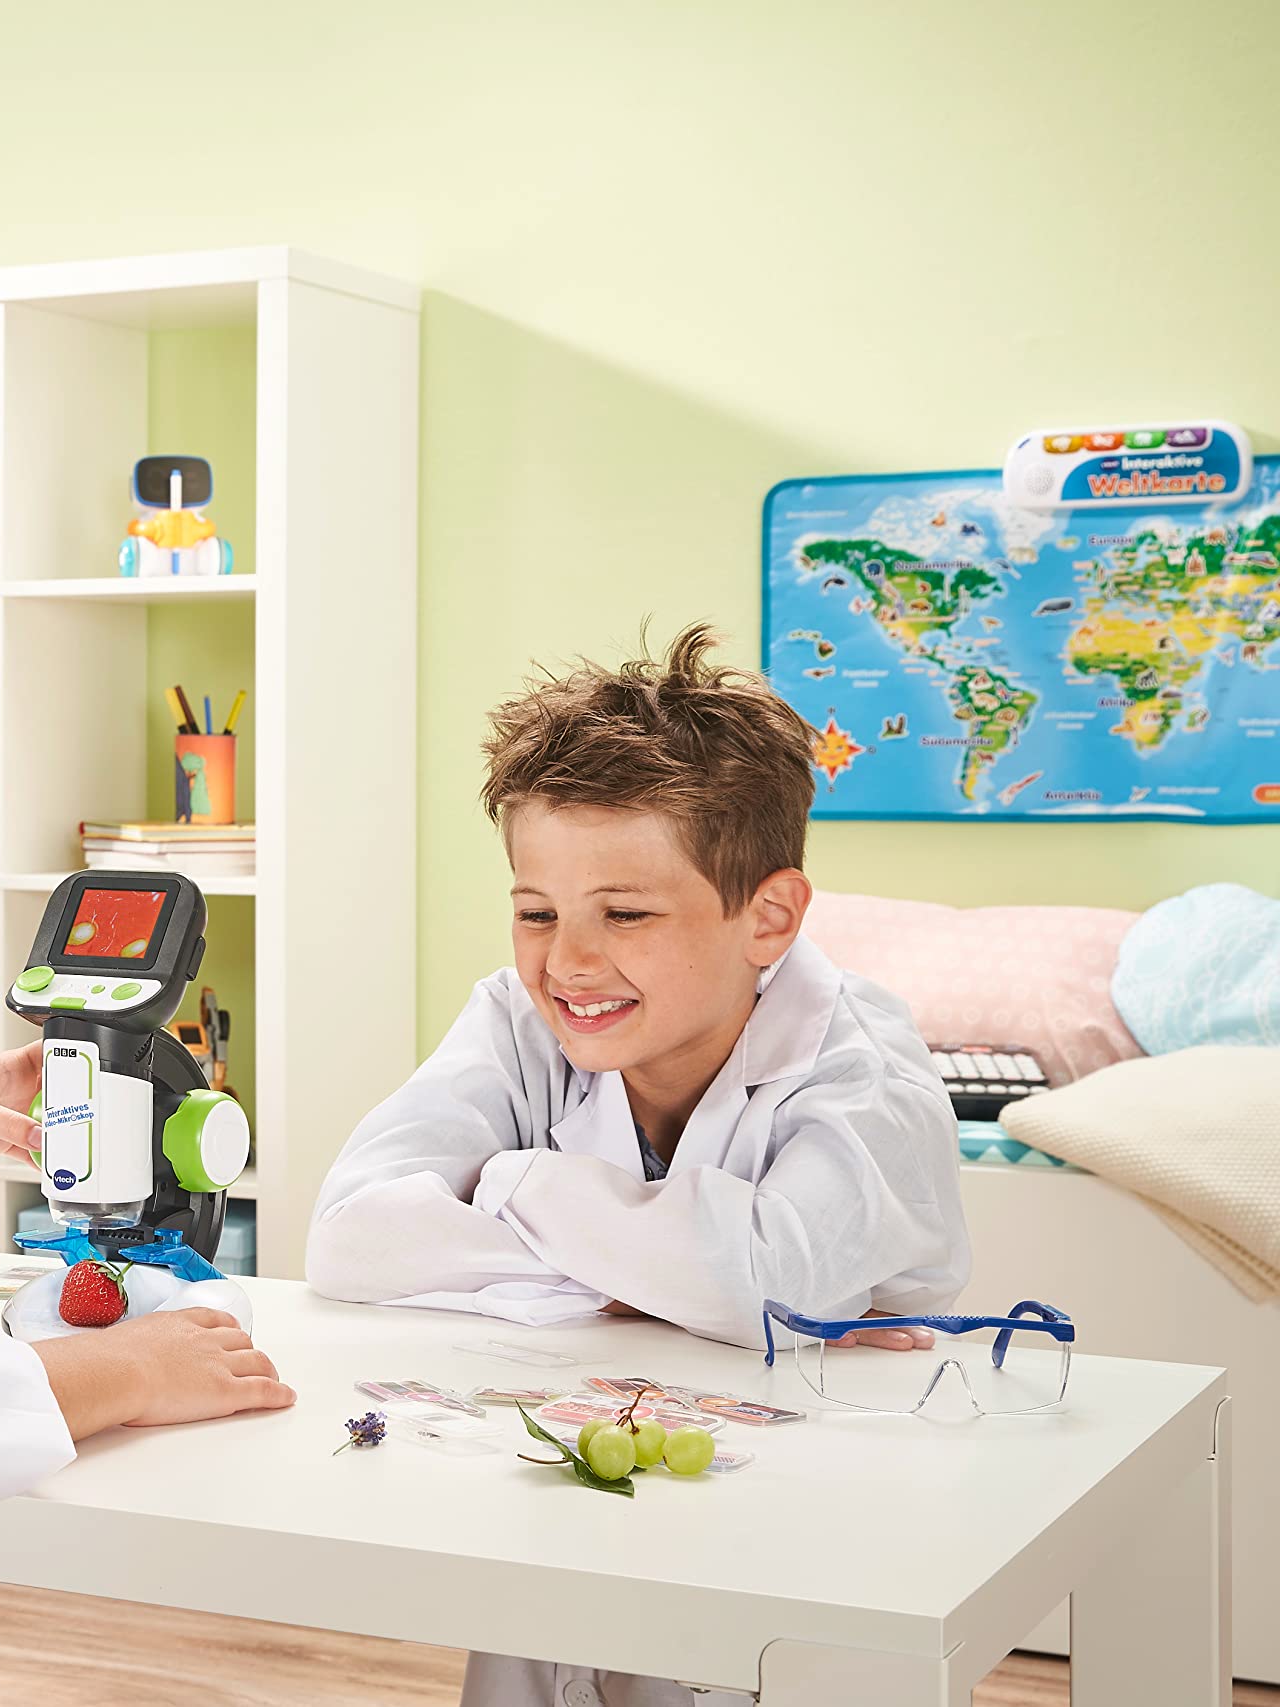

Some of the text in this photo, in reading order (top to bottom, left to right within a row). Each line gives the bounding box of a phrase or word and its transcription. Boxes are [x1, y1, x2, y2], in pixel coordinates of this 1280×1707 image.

[1121, 454, 1204, 470] Interaktive
[1087, 470, 1226, 497] Weltkarte
[53, 1047, 78, 1058] BBC
[46, 1103, 90, 1119] Interaktives
